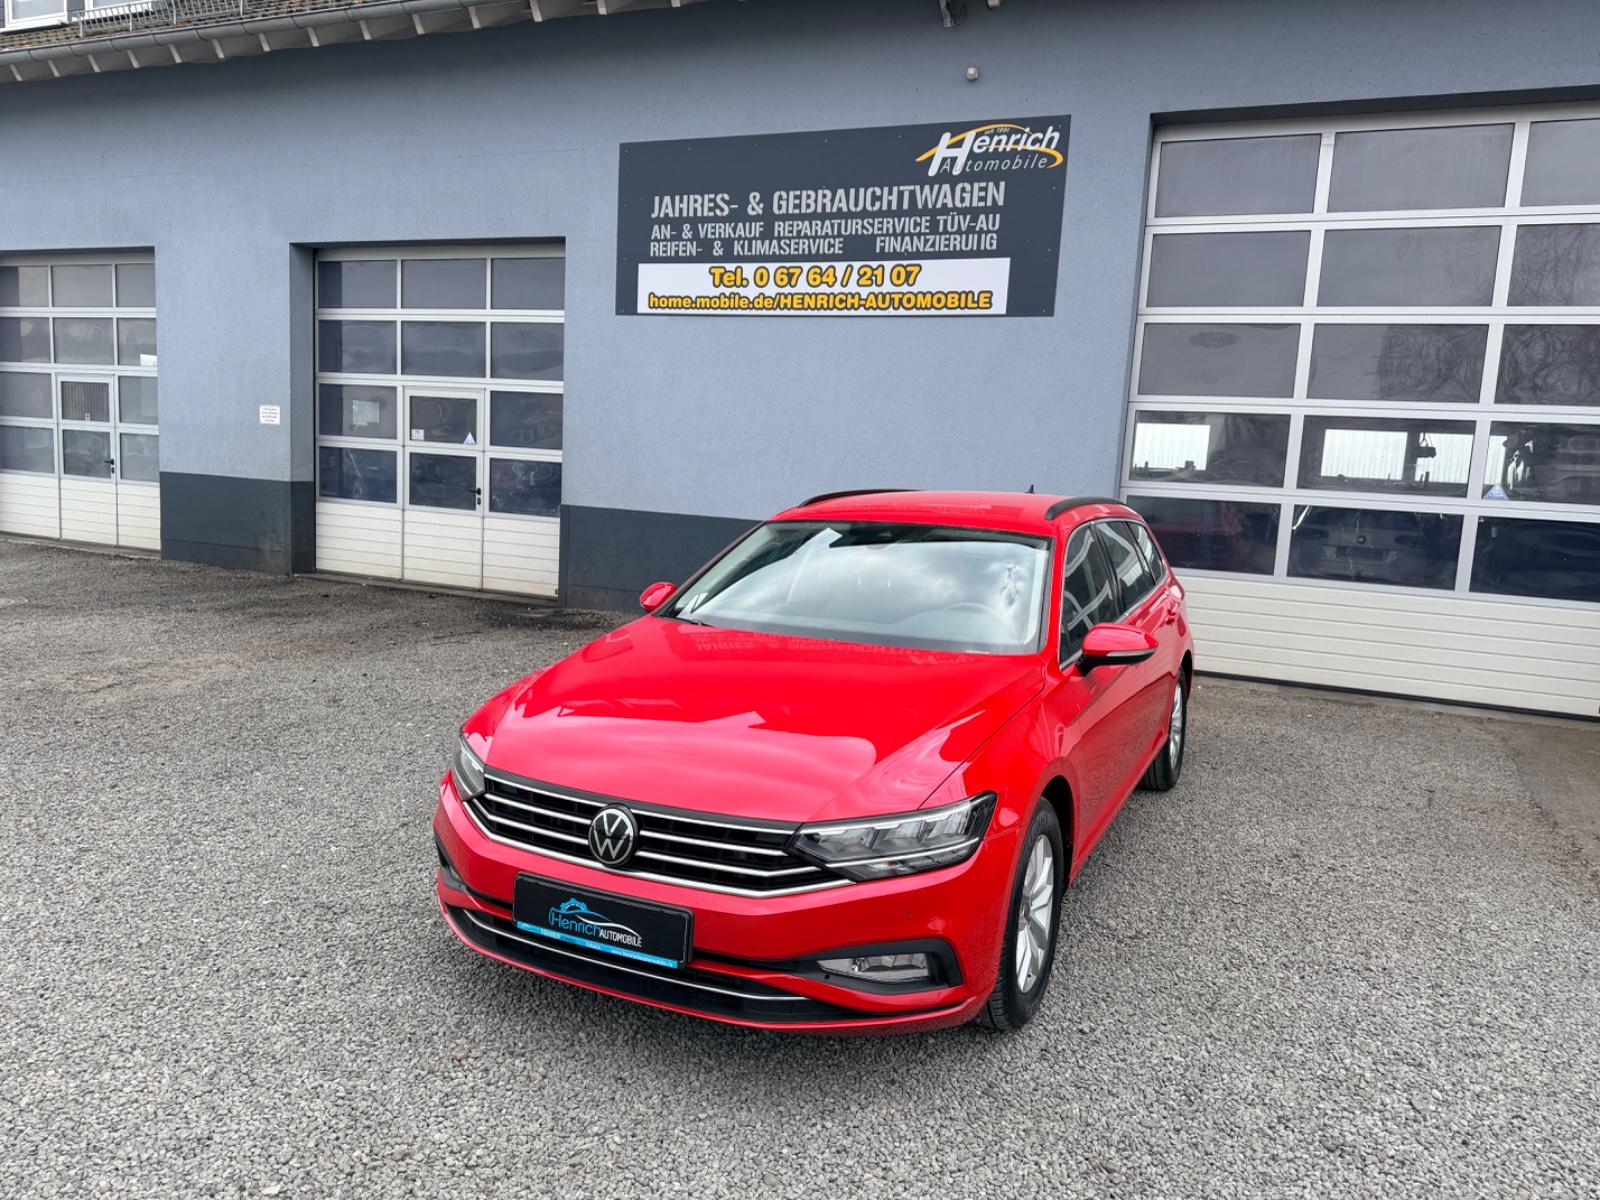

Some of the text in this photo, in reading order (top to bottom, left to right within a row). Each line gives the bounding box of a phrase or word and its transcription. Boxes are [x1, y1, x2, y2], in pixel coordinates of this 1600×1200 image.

[928, 126, 1060, 176] Henrich
[940, 154, 1047, 174] Atomobile
[651, 181, 1006, 218] JAHRES- & GEBRAUCHTWAGEN
[651, 211, 1000, 240] AN- & VERKAUF REPARATURSERVICE TÜV-AU
[650, 241, 703, 257] REIFEN-
[713, 240, 724, 256] &
[733, 238, 844, 256] KLIMASERVICE
[709, 263, 922, 288] Tel. 0 67 64 / 21 07
[648, 290, 993, 310] home.mobile.de/HENRICH-AUTOMOBILE
[550, 911, 600, 937] Henrich
[600, 929, 643, 948] AUTOMOBILE
